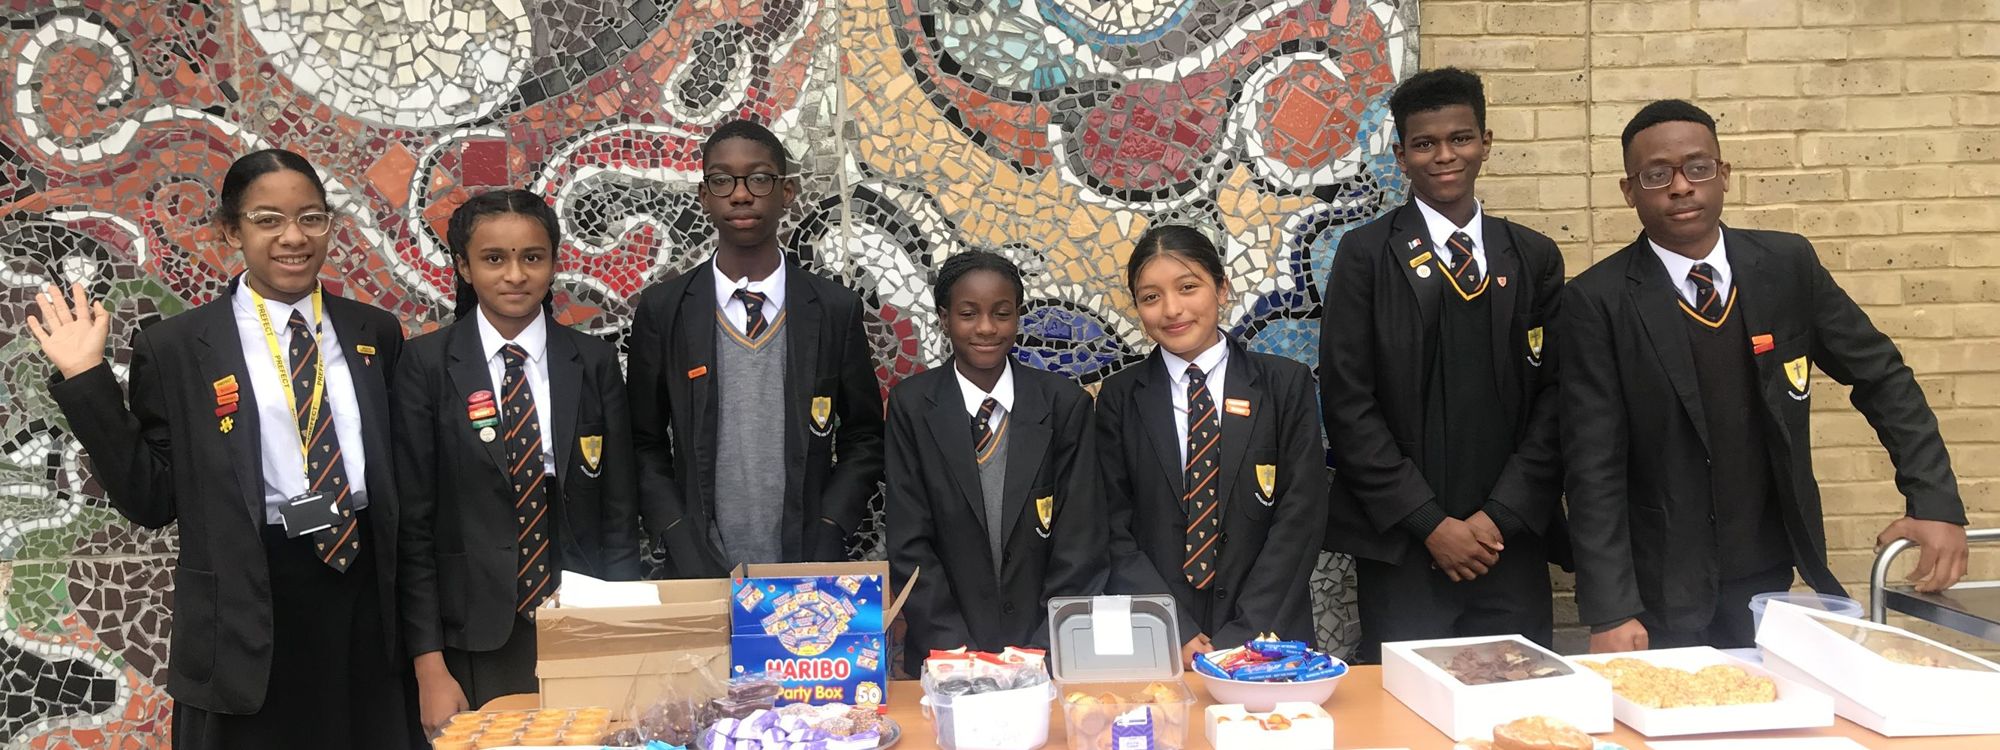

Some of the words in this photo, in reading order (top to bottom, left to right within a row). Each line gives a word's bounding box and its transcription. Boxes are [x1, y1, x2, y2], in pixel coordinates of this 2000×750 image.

[257, 304, 273, 336] PREFECT
[274, 355, 290, 388] PREFECT
[766, 658, 850, 680] HARIBO
[815, 685, 844, 700] Box
[857, 684, 881, 704] 50
